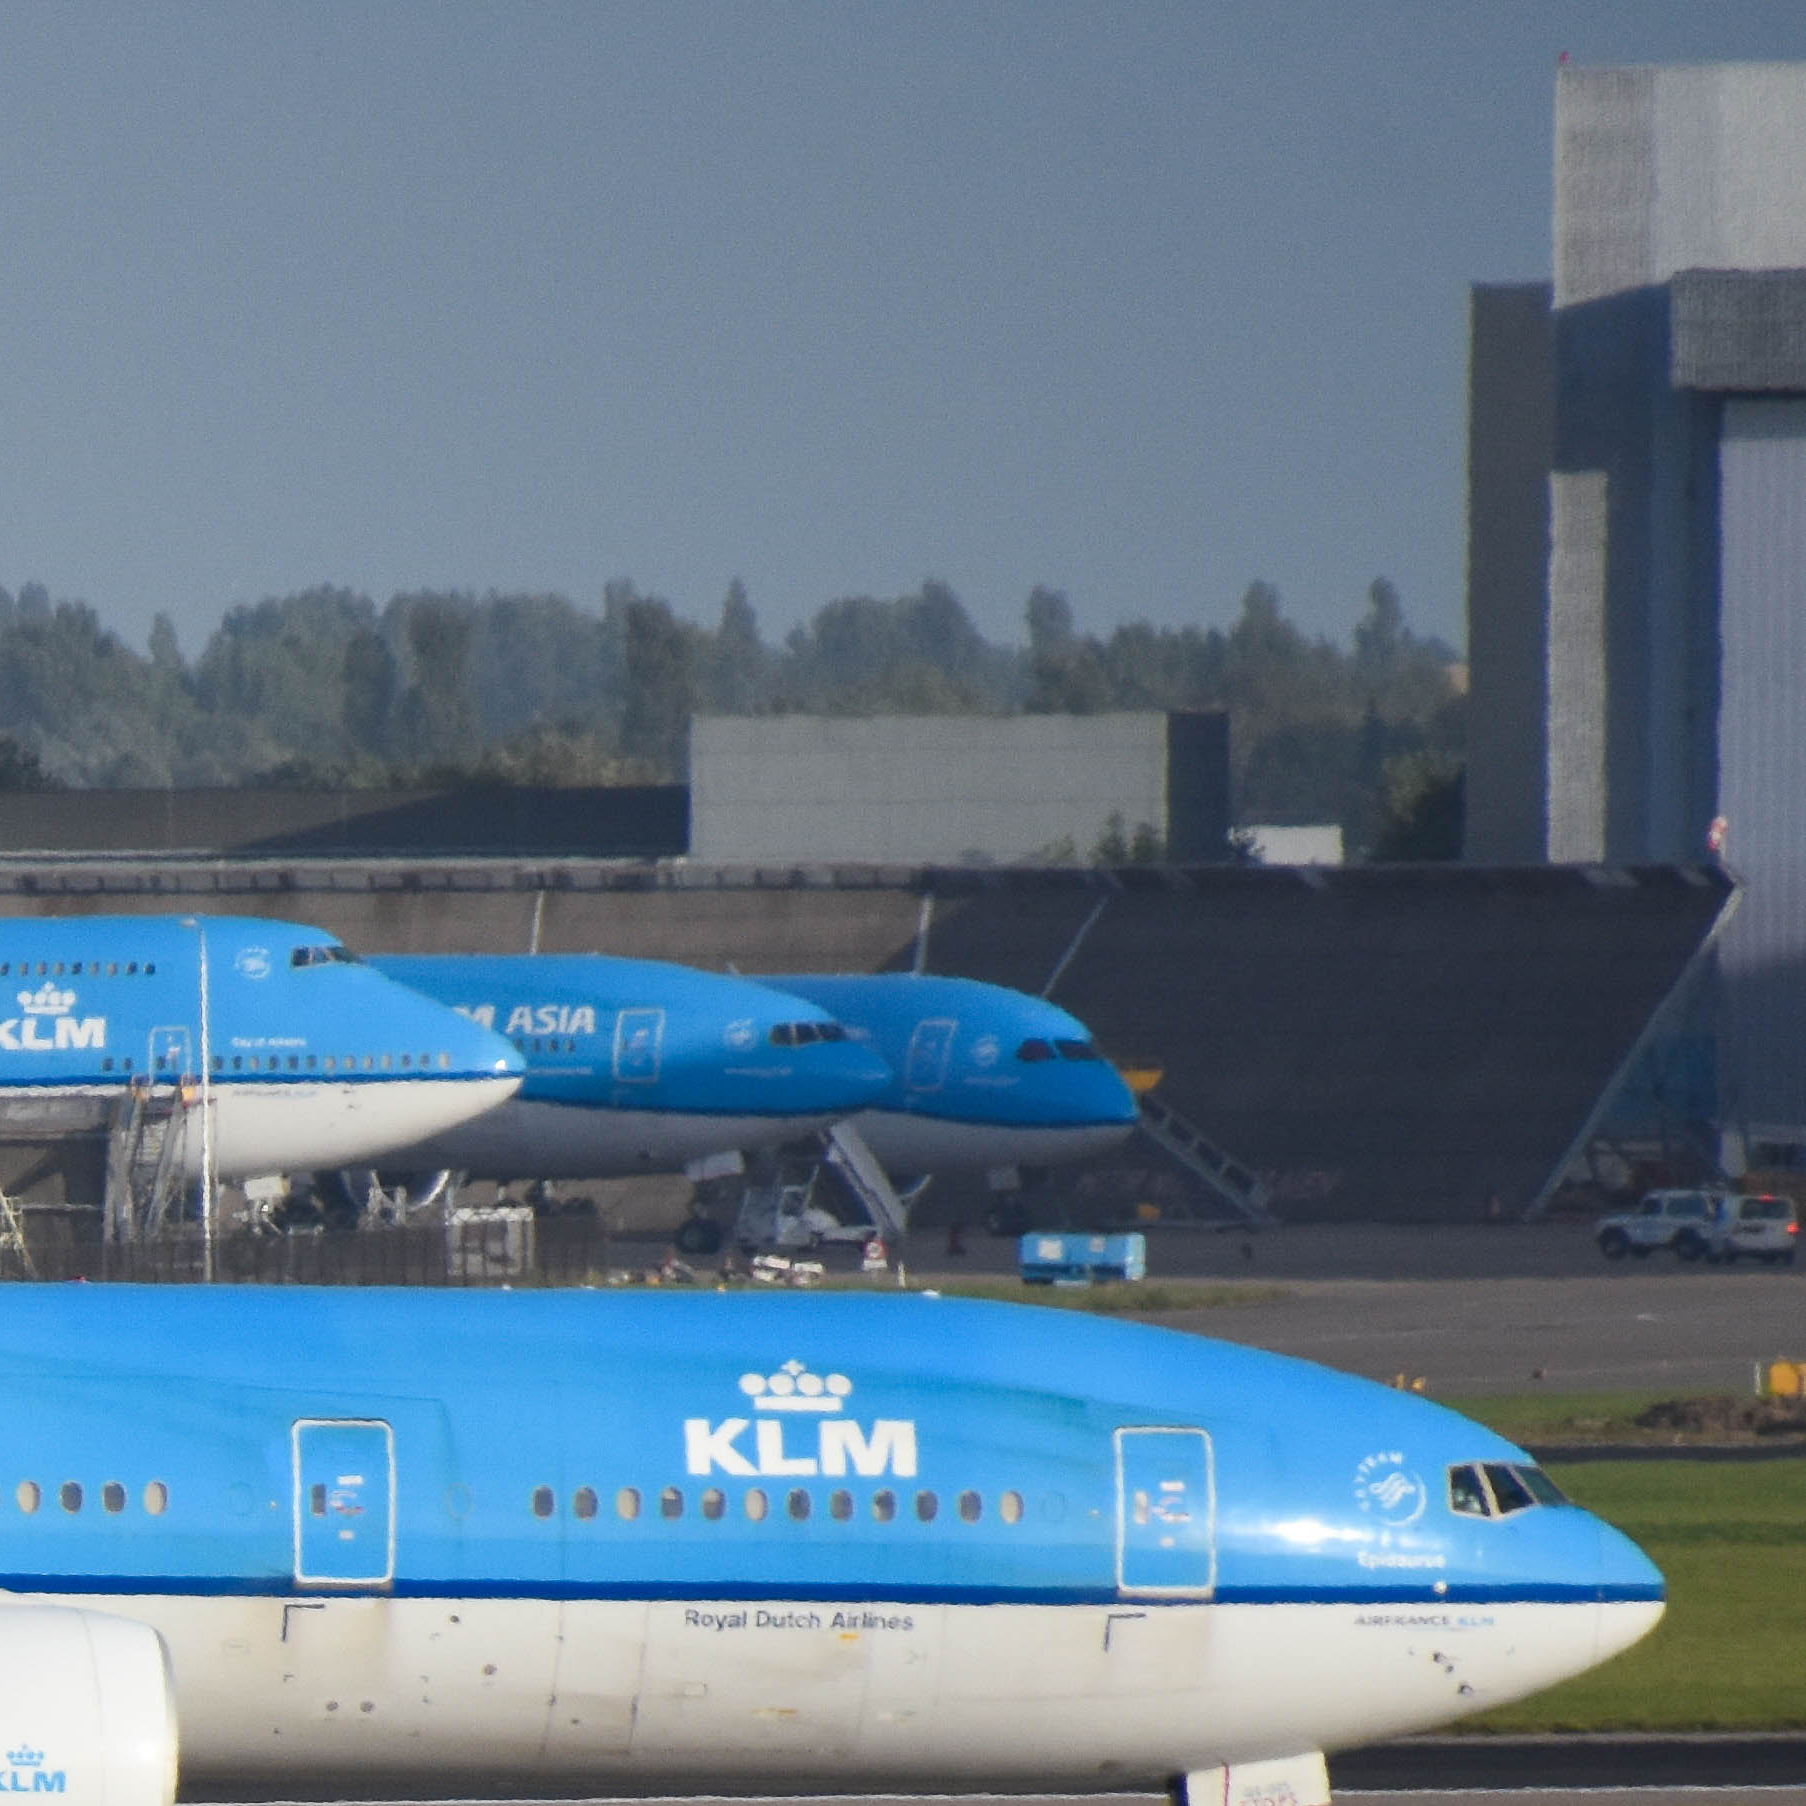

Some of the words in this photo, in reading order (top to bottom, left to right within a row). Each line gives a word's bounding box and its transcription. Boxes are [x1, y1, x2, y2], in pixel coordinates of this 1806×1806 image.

[505, 1005, 596, 1034] ASIA
[685, 1418, 917, 1477] KLM
[685, 1609, 747, 1632] Royal
[755, 1610, 821, 1629] Dutch
[830, 1612, 914, 1632] Airlines
